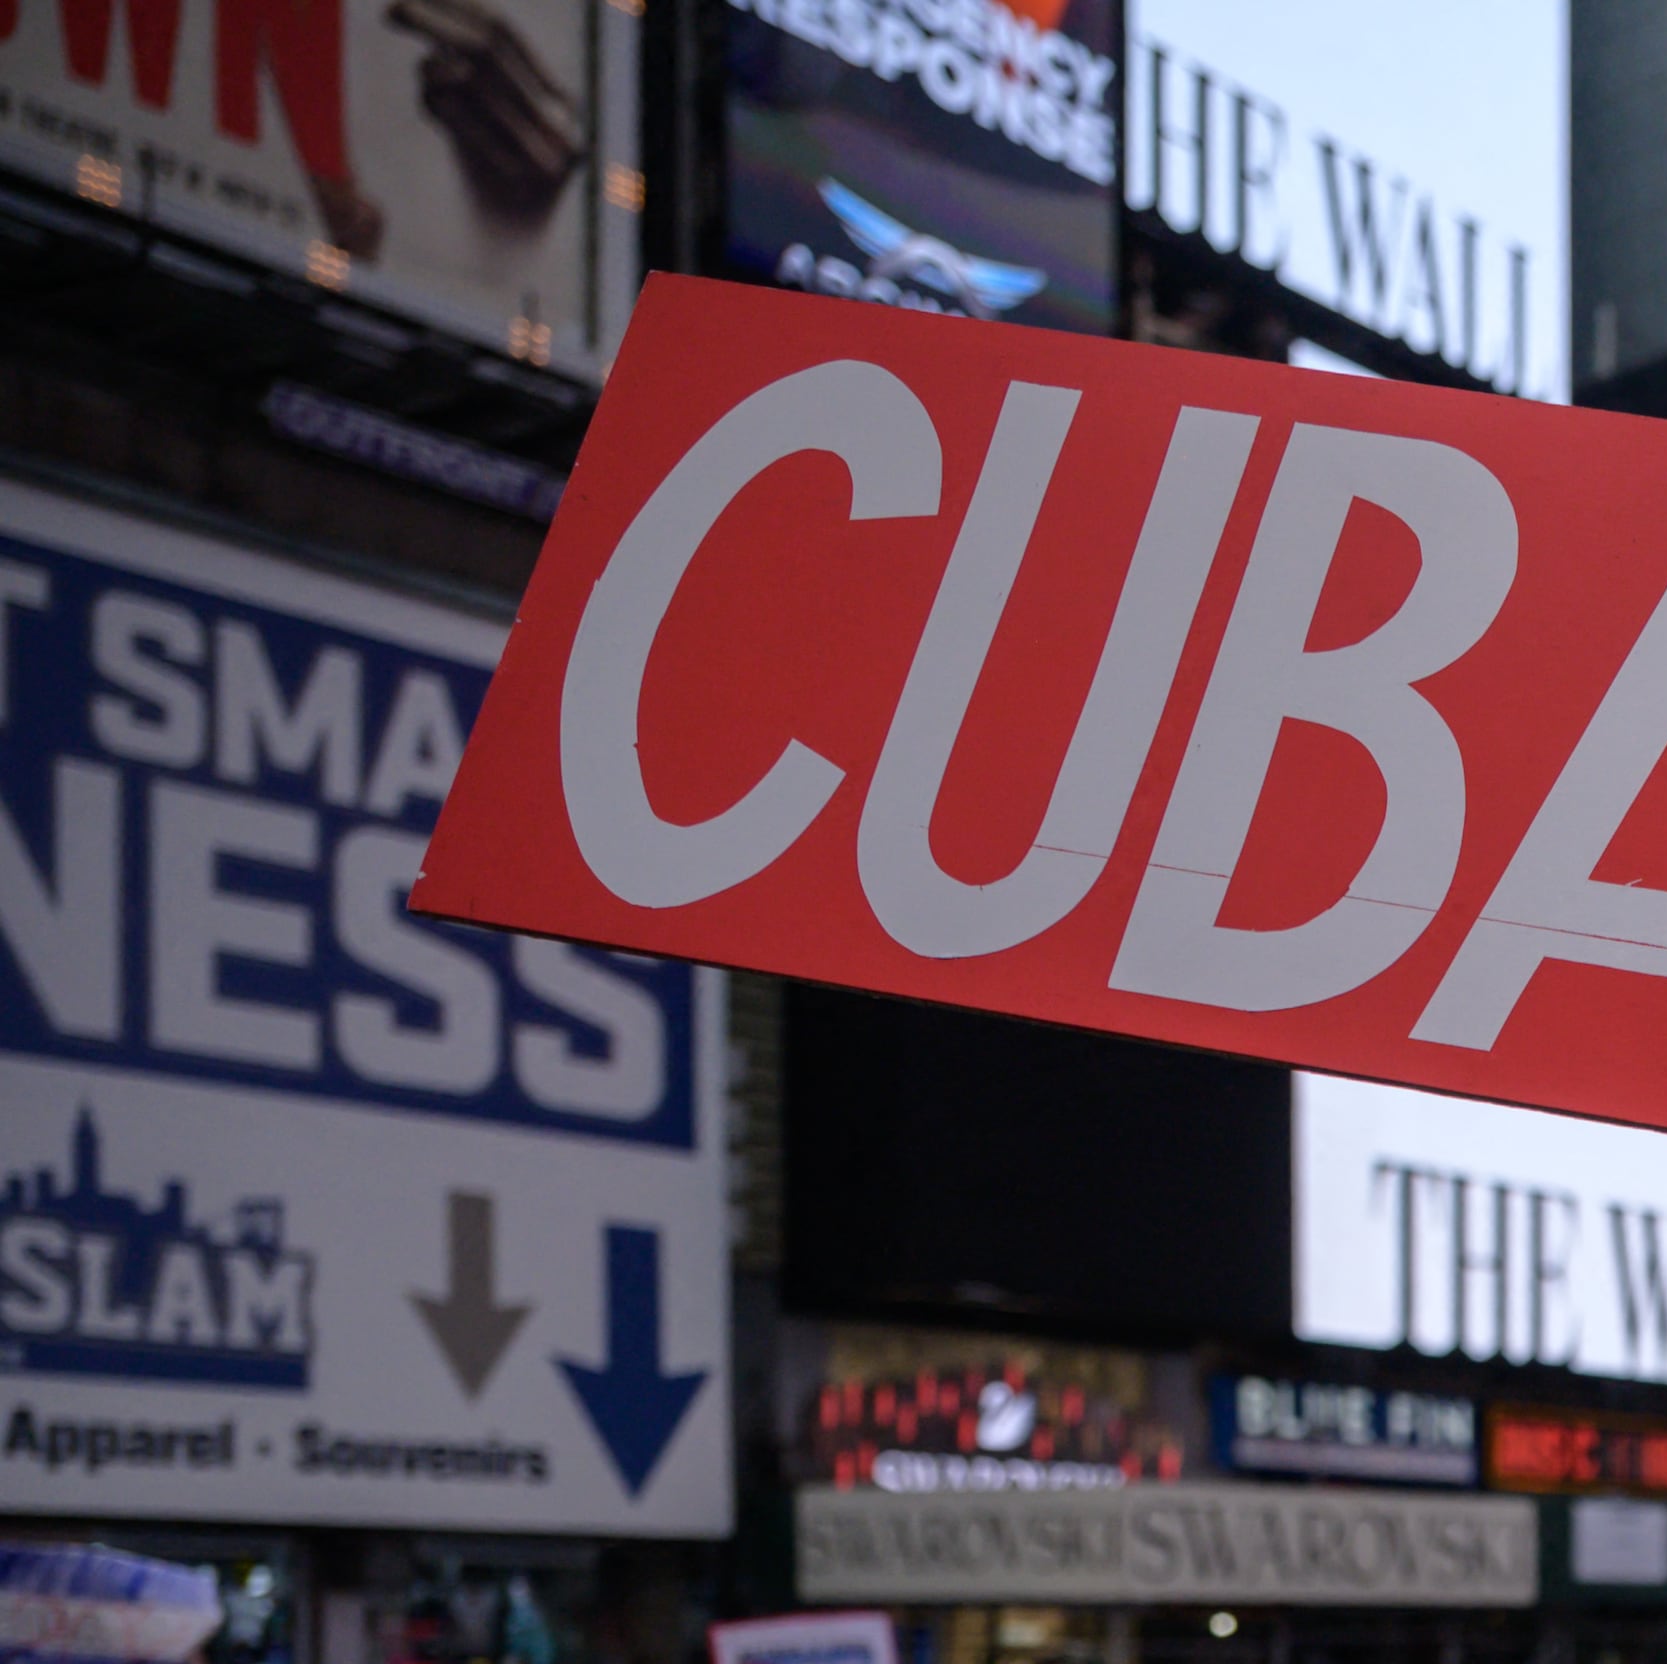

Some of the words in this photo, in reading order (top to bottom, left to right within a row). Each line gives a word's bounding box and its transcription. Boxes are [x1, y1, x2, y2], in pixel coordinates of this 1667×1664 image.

[0, 1212, 309, 1354] SLAM
[1370, 1155, 1587, 1370] THE
[3, 1404, 235, 1475] Apparel
[292, 1421, 550, 1484] Souvenirs
